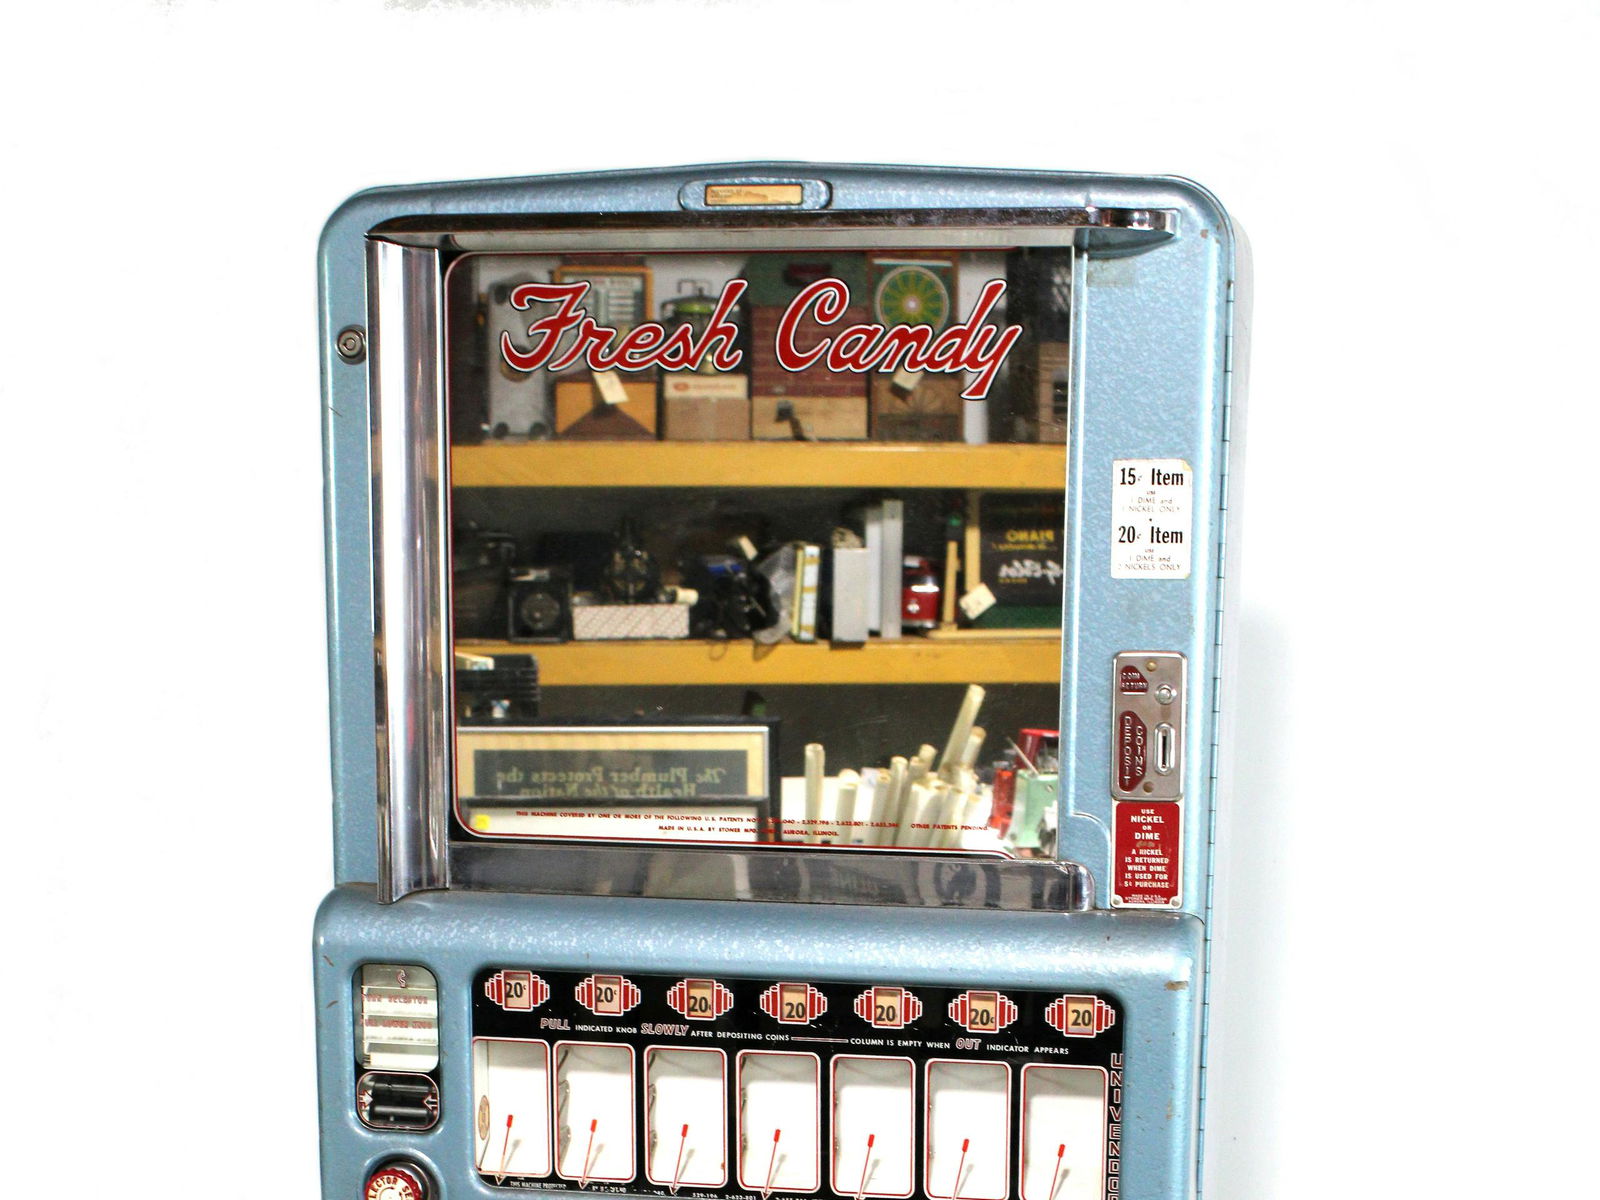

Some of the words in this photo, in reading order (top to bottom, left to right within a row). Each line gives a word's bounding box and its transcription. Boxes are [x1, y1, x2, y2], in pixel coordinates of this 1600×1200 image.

[500, 277, 748, 373] Fresh
[775, 277, 1023, 401] Candy
[1151, 467, 1184, 486] Item
[1150, 526, 1183, 544] Item
[1123, 716, 1133, 786] DEPOSIT
[1135, 725, 1144, 777] COINS
[1134, 832, 1160, 840] DIME
[1135, 881, 1169, 889] PURCHASE
[540, 1018, 571, 1031] PULL
[575, 1024, 614, 1033] INDICATED
[616, 1025, 637, 1034] KNOB
[640, 1022, 690, 1037] SLOWLY
[690, 1030, 713, 1038] AFTER
[716, 1031, 763, 1040] DEPOSITING
[765, 1033, 790, 1041] COINS
[850, 1037, 884, 1046] COLUMN
[887, 1039, 895, 1047] IS
[897, 1039, 923, 1047] EMPTY
[926, 1041, 951, 1049] WHEN
[955, 1037, 982, 1051] OUT
[986, 1044, 1029, 1053] INDICATOR
[1033, 1046, 1069, 1055] APPEARS
